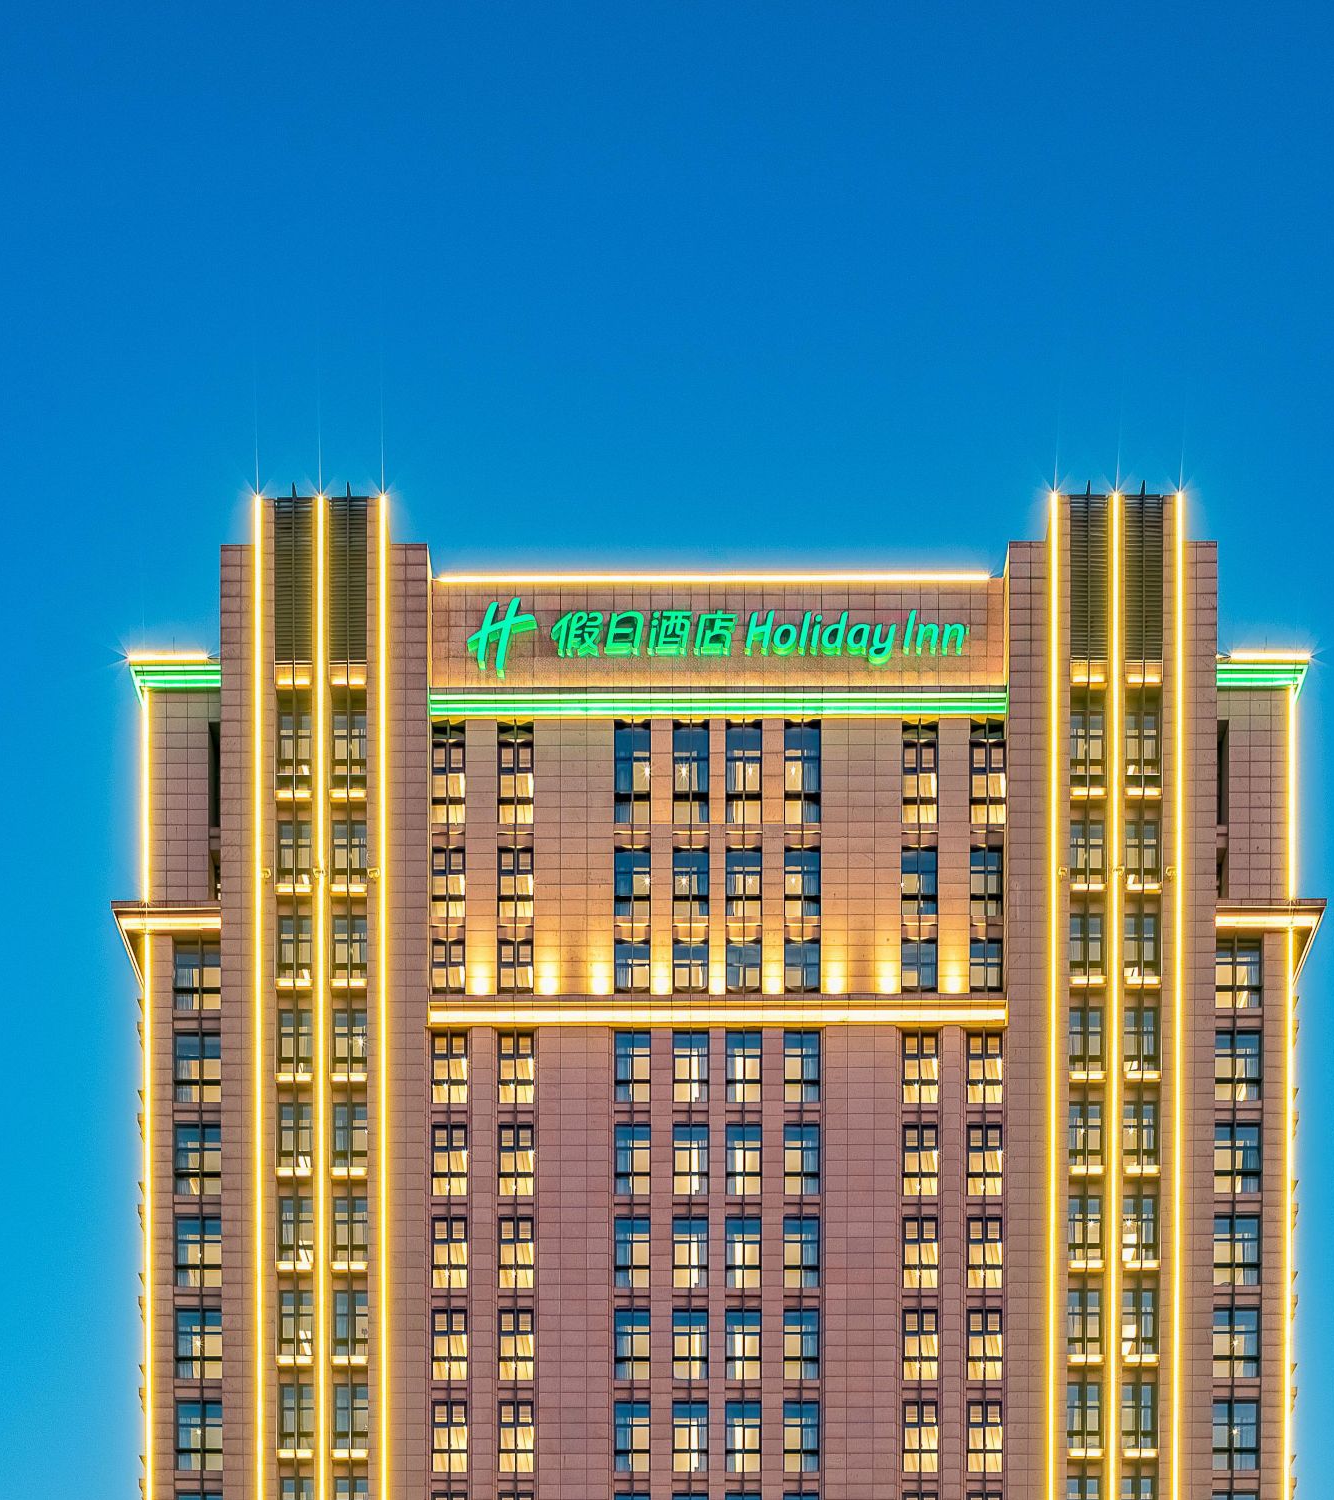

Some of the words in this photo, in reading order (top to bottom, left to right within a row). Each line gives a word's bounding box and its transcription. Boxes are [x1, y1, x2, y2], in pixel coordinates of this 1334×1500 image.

[550, 610, 739, 658] 假日酒店
[744, 609, 897, 667] Holiday
[902, 609, 965, 657] Inn
